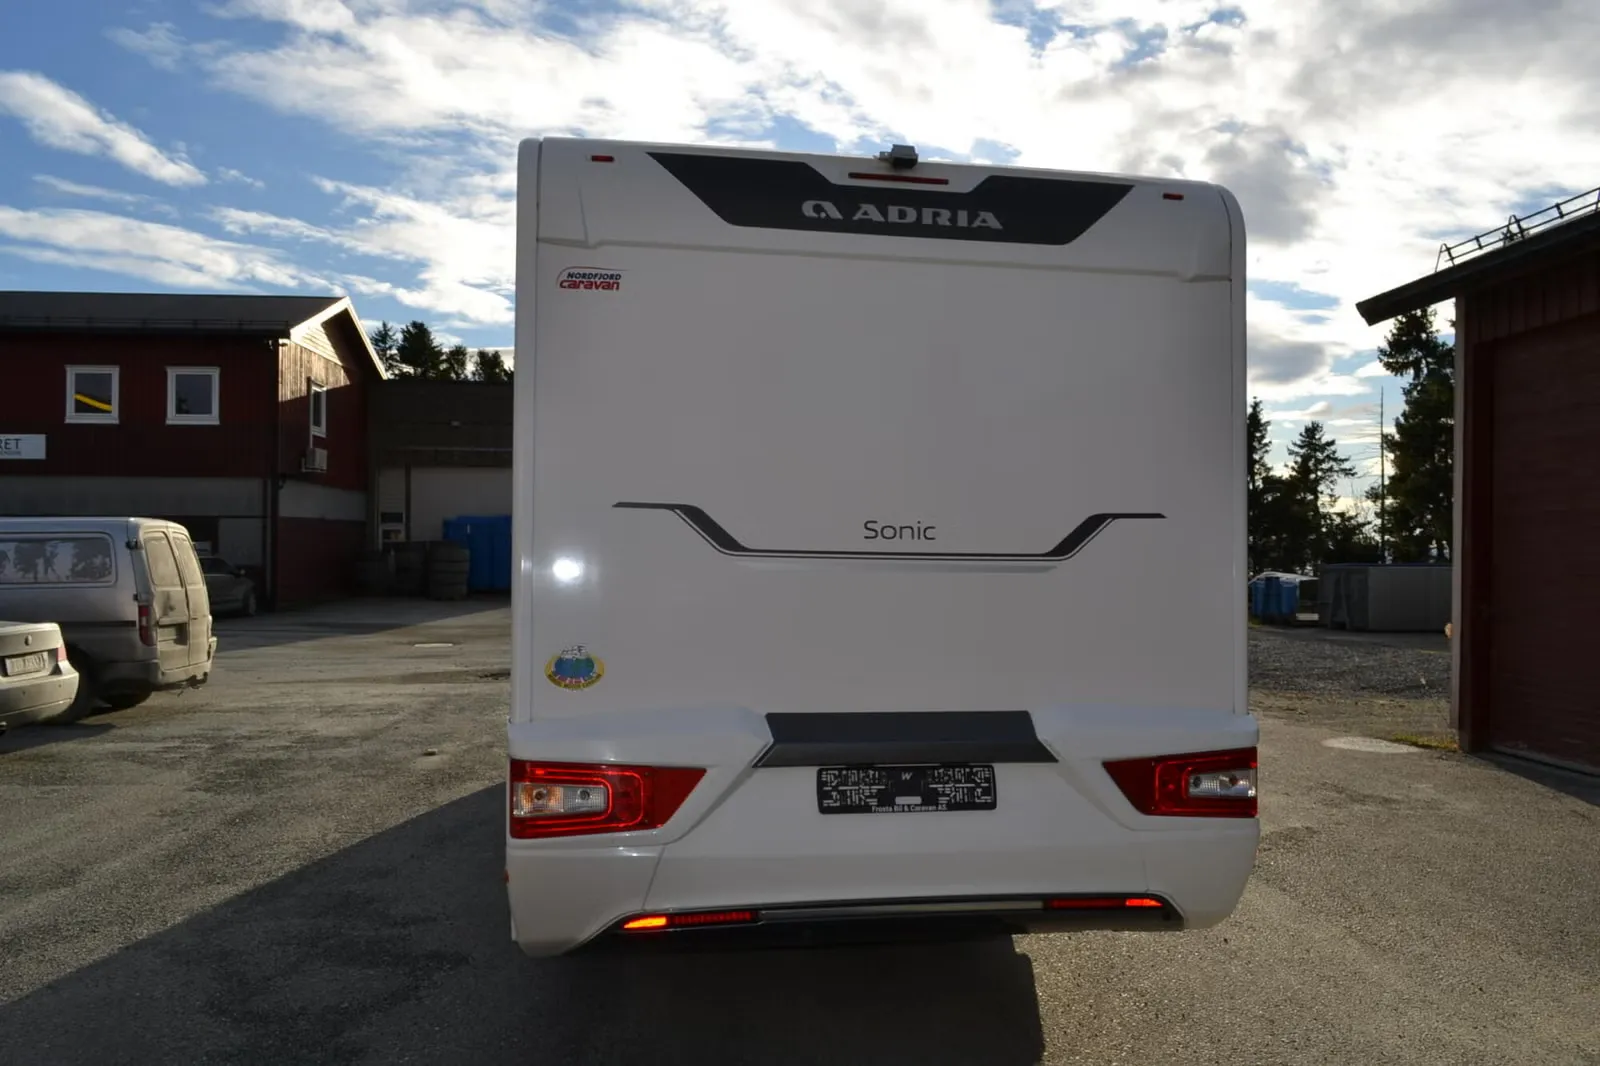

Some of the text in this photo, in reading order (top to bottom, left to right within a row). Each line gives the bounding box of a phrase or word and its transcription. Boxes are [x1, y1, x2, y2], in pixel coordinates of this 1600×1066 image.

[852, 203, 1003, 229] ADRIA
[567, 272, 621, 280] NORDFJORD
[560, 279, 620, 290] caravan
[863, 520, 936, 540] Sonic
[910, 804, 937, 812] Caravan
